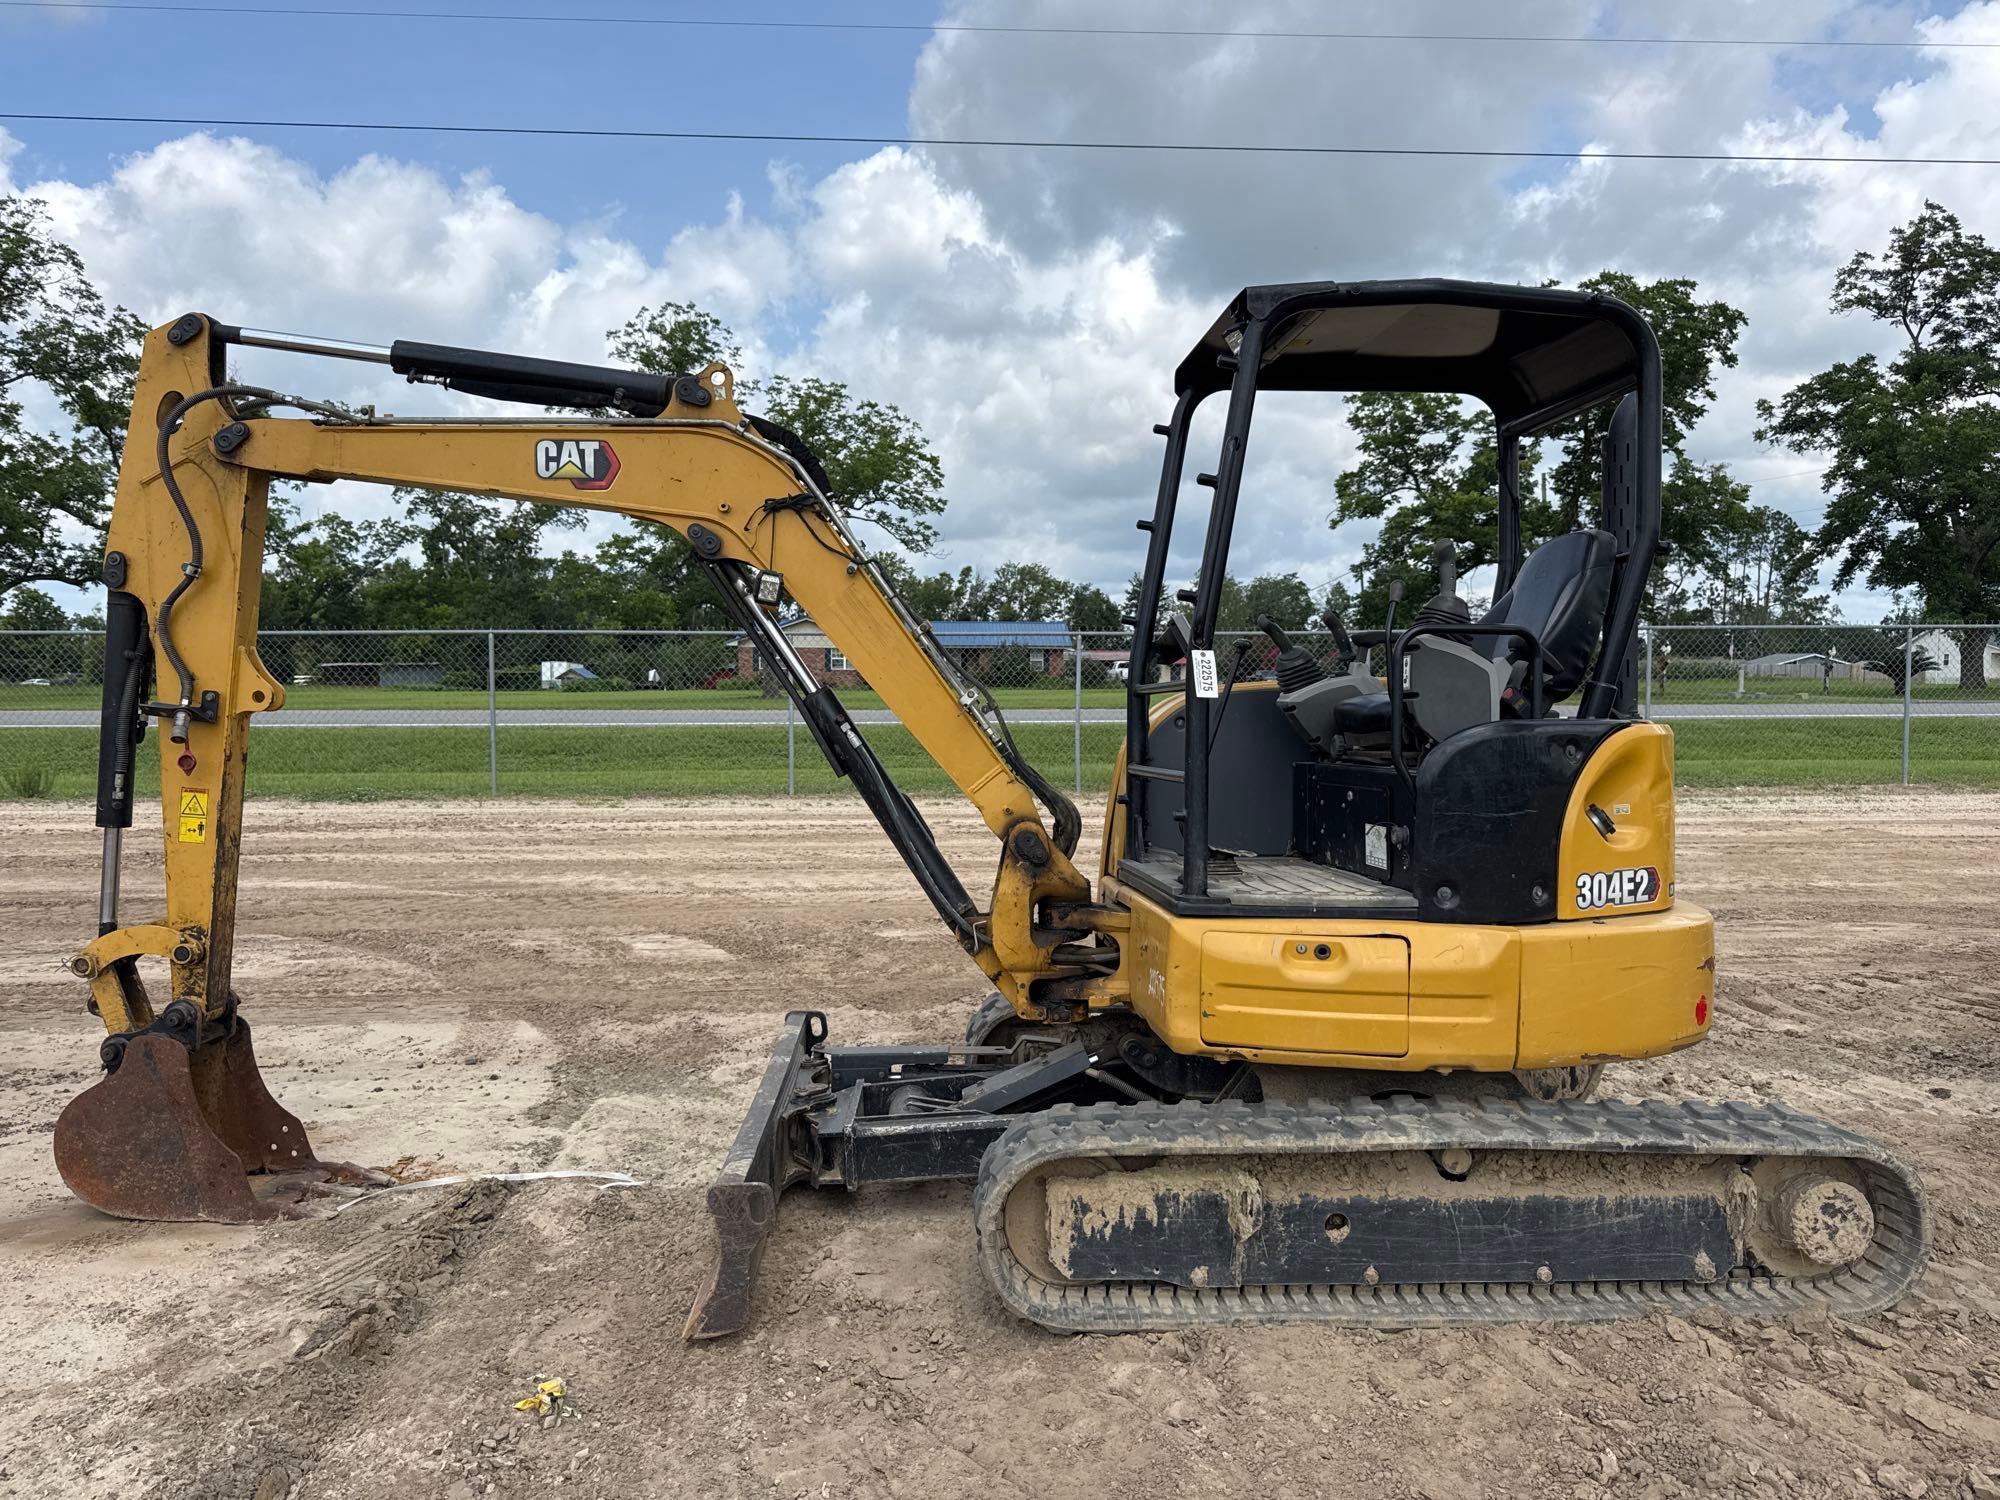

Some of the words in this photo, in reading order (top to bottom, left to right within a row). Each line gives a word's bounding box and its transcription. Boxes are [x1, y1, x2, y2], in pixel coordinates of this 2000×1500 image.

[536, 440, 600, 479] CAT
[1200, 659, 1213, 692] 222575
[1577, 867, 1649, 909] 304E2
